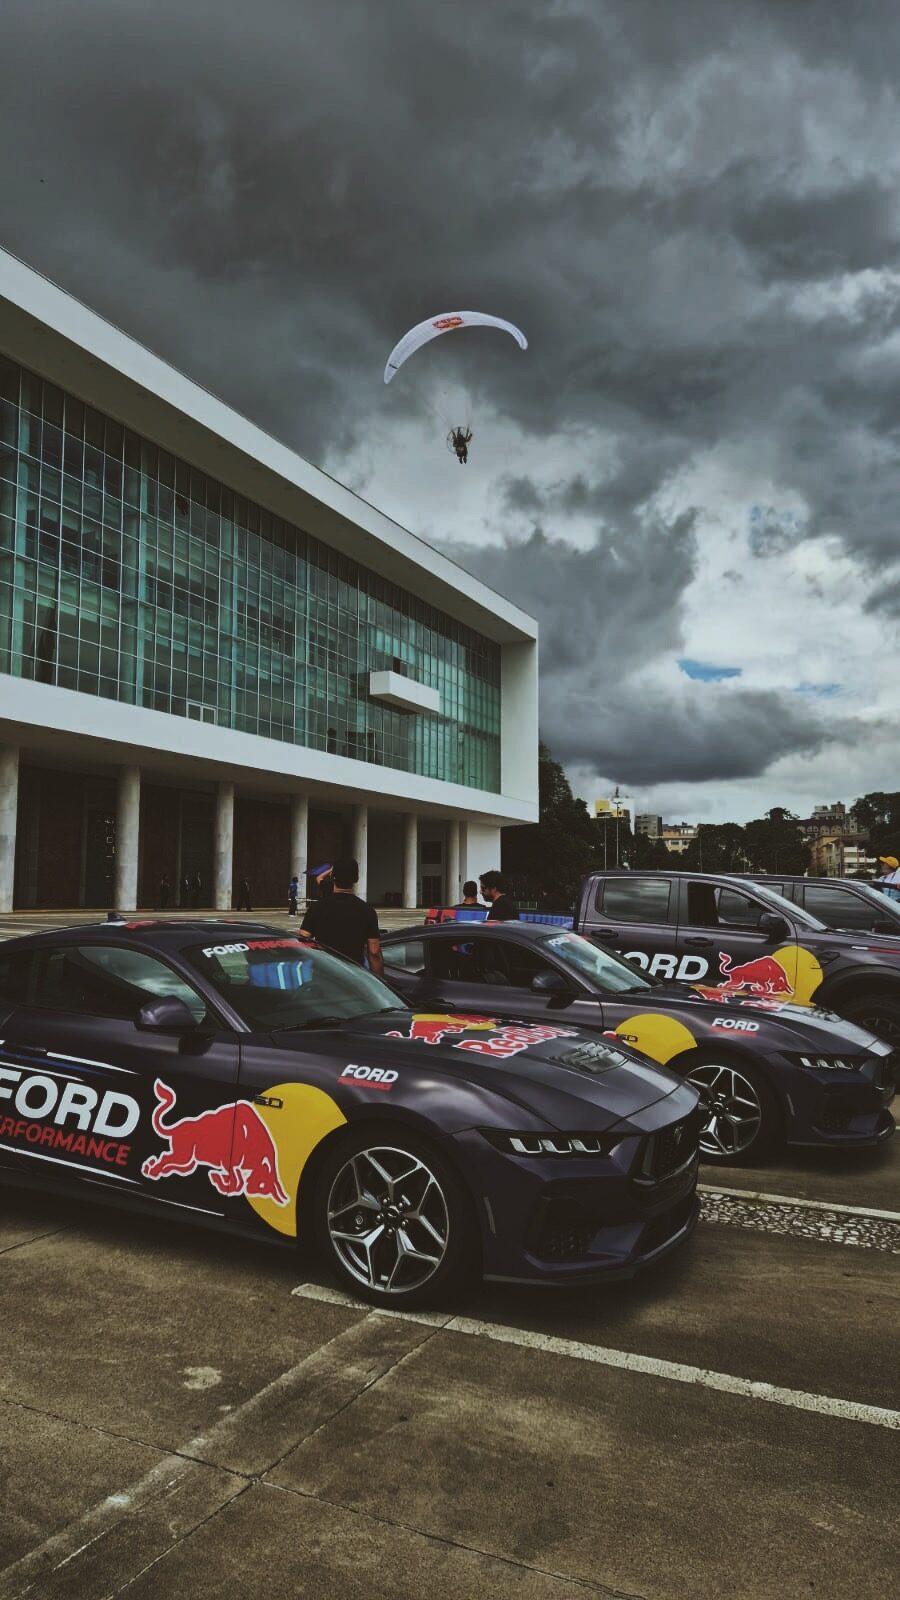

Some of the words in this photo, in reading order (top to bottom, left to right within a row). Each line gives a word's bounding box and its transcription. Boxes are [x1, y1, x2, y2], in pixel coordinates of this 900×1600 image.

[202, 943, 250, 958] FORD
[619, 950, 709, 981] ORD
[711, 1018, 760, 1032] FORD
[341, 1064, 399, 1083] FORD
[0, 1115, 132, 1166] RFORMANCE
